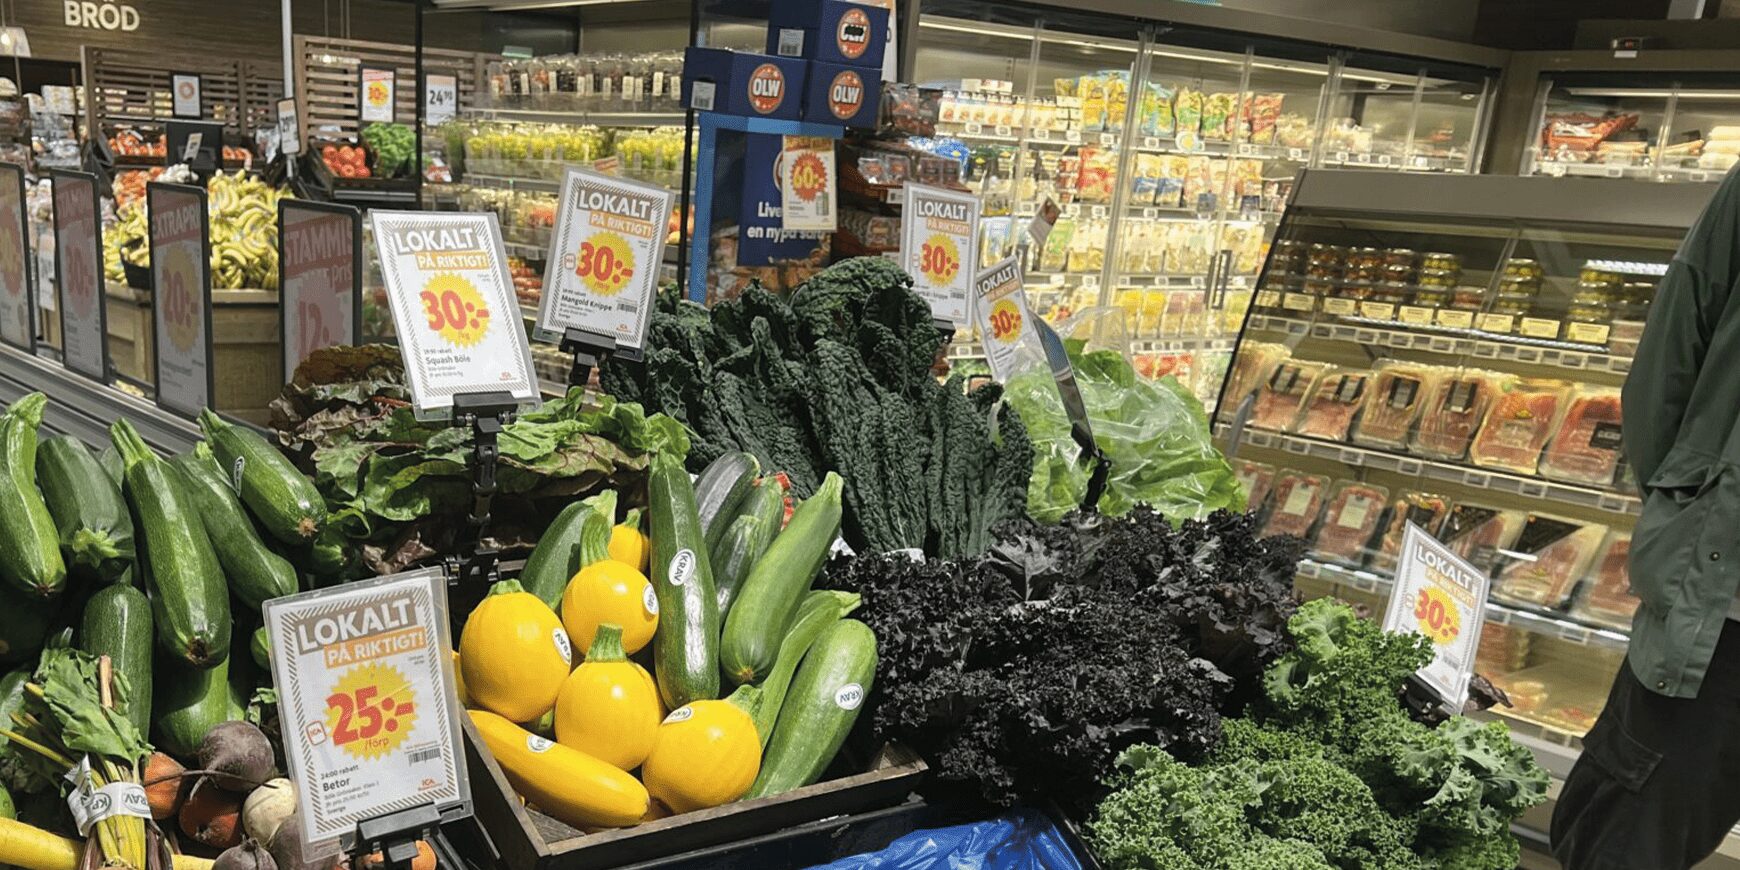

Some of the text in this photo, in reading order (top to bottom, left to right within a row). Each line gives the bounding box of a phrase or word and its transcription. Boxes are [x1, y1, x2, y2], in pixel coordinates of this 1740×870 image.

[64, 0, 140, 31] BRÖD
[752, 78, 781, 97] OLW
[832, 85, 860, 104] OLW
[579, 189, 651, 219] LOKALT
[919, 201, 966, 220] LOKALT
[591, 213, 652, 238] PÅ RIKTIGT!
[746, 226, 764, 239] en
[394, 228, 474, 253] LOKALT
[417, 252, 487, 268] PÅ RIKTIGT!
[576, 241, 633, 284] 30:-
[920, 243, 960, 276] 30:-
[977, 266, 1013, 296] LOKALT
[420, 290, 490, 331] 30:-
[561, 295, 589, 306] Mangold
[425, 355, 453, 366] Squash
[674, 555, 688, 581] KRAV
[1417, 544, 1472, 590] LOKALT
[1414, 588, 1459, 636] 30:-
[298, 598, 411, 652] LOKALT
[327, 632, 424, 665] PÅ RIKTIGT!
[840, 690, 860, 703] KRAV
[326, 685, 415, 746] 25:-
[321, 765, 359, 780] 24:00 rabatt
[322, 778, 350, 792] Betor
[124, 793, 147, 806] RAV
